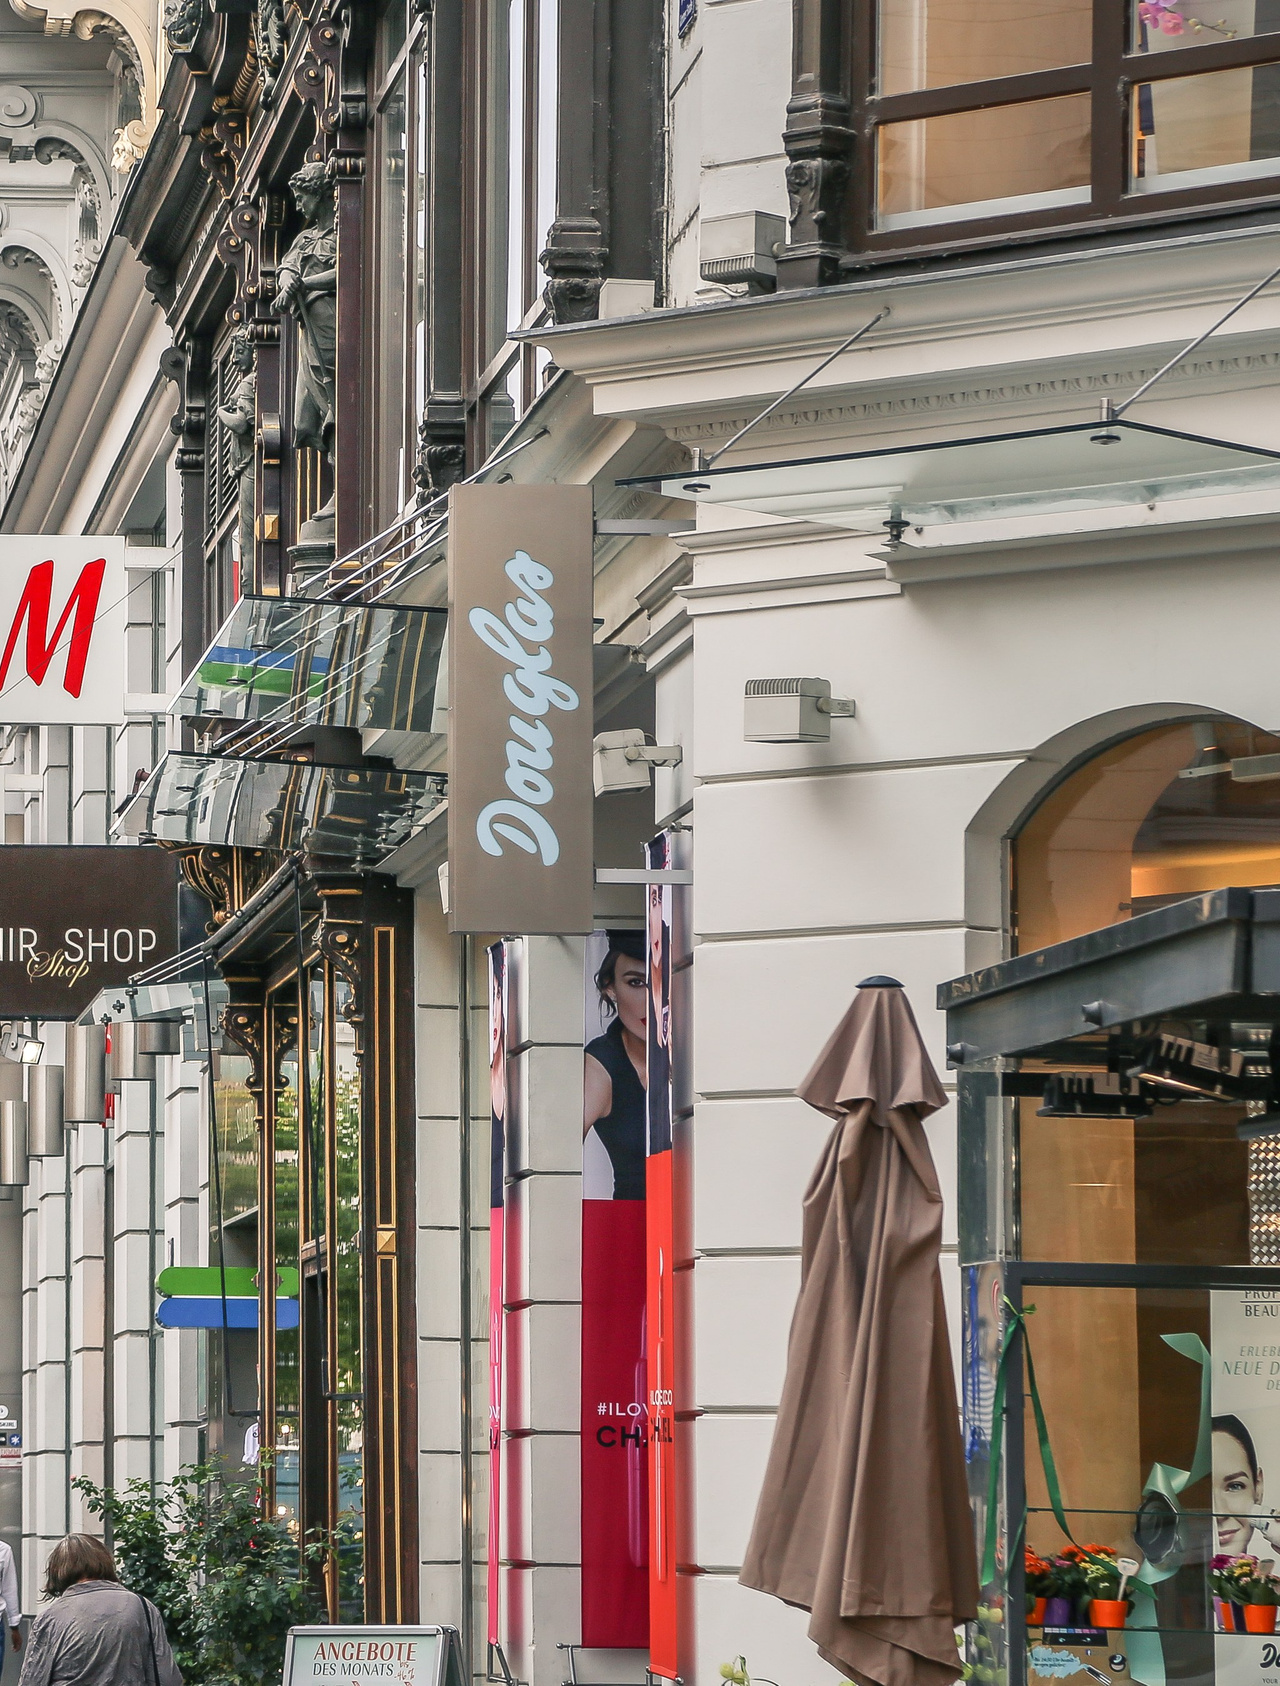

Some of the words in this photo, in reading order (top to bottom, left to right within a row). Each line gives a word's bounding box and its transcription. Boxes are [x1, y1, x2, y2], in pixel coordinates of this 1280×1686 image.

[468, 549, 580, 867] Douglas
[63, 928, 157, 963] SHOP
[26, 949, 89, 987] Shop
[1222, 1361, 1263, 1375] NEUE
[313, 1642, 418, 1661] ANGEBOTE
[313, 1663, 336, 1676] DES
[340, 1663, 394, 1676] MONATS
